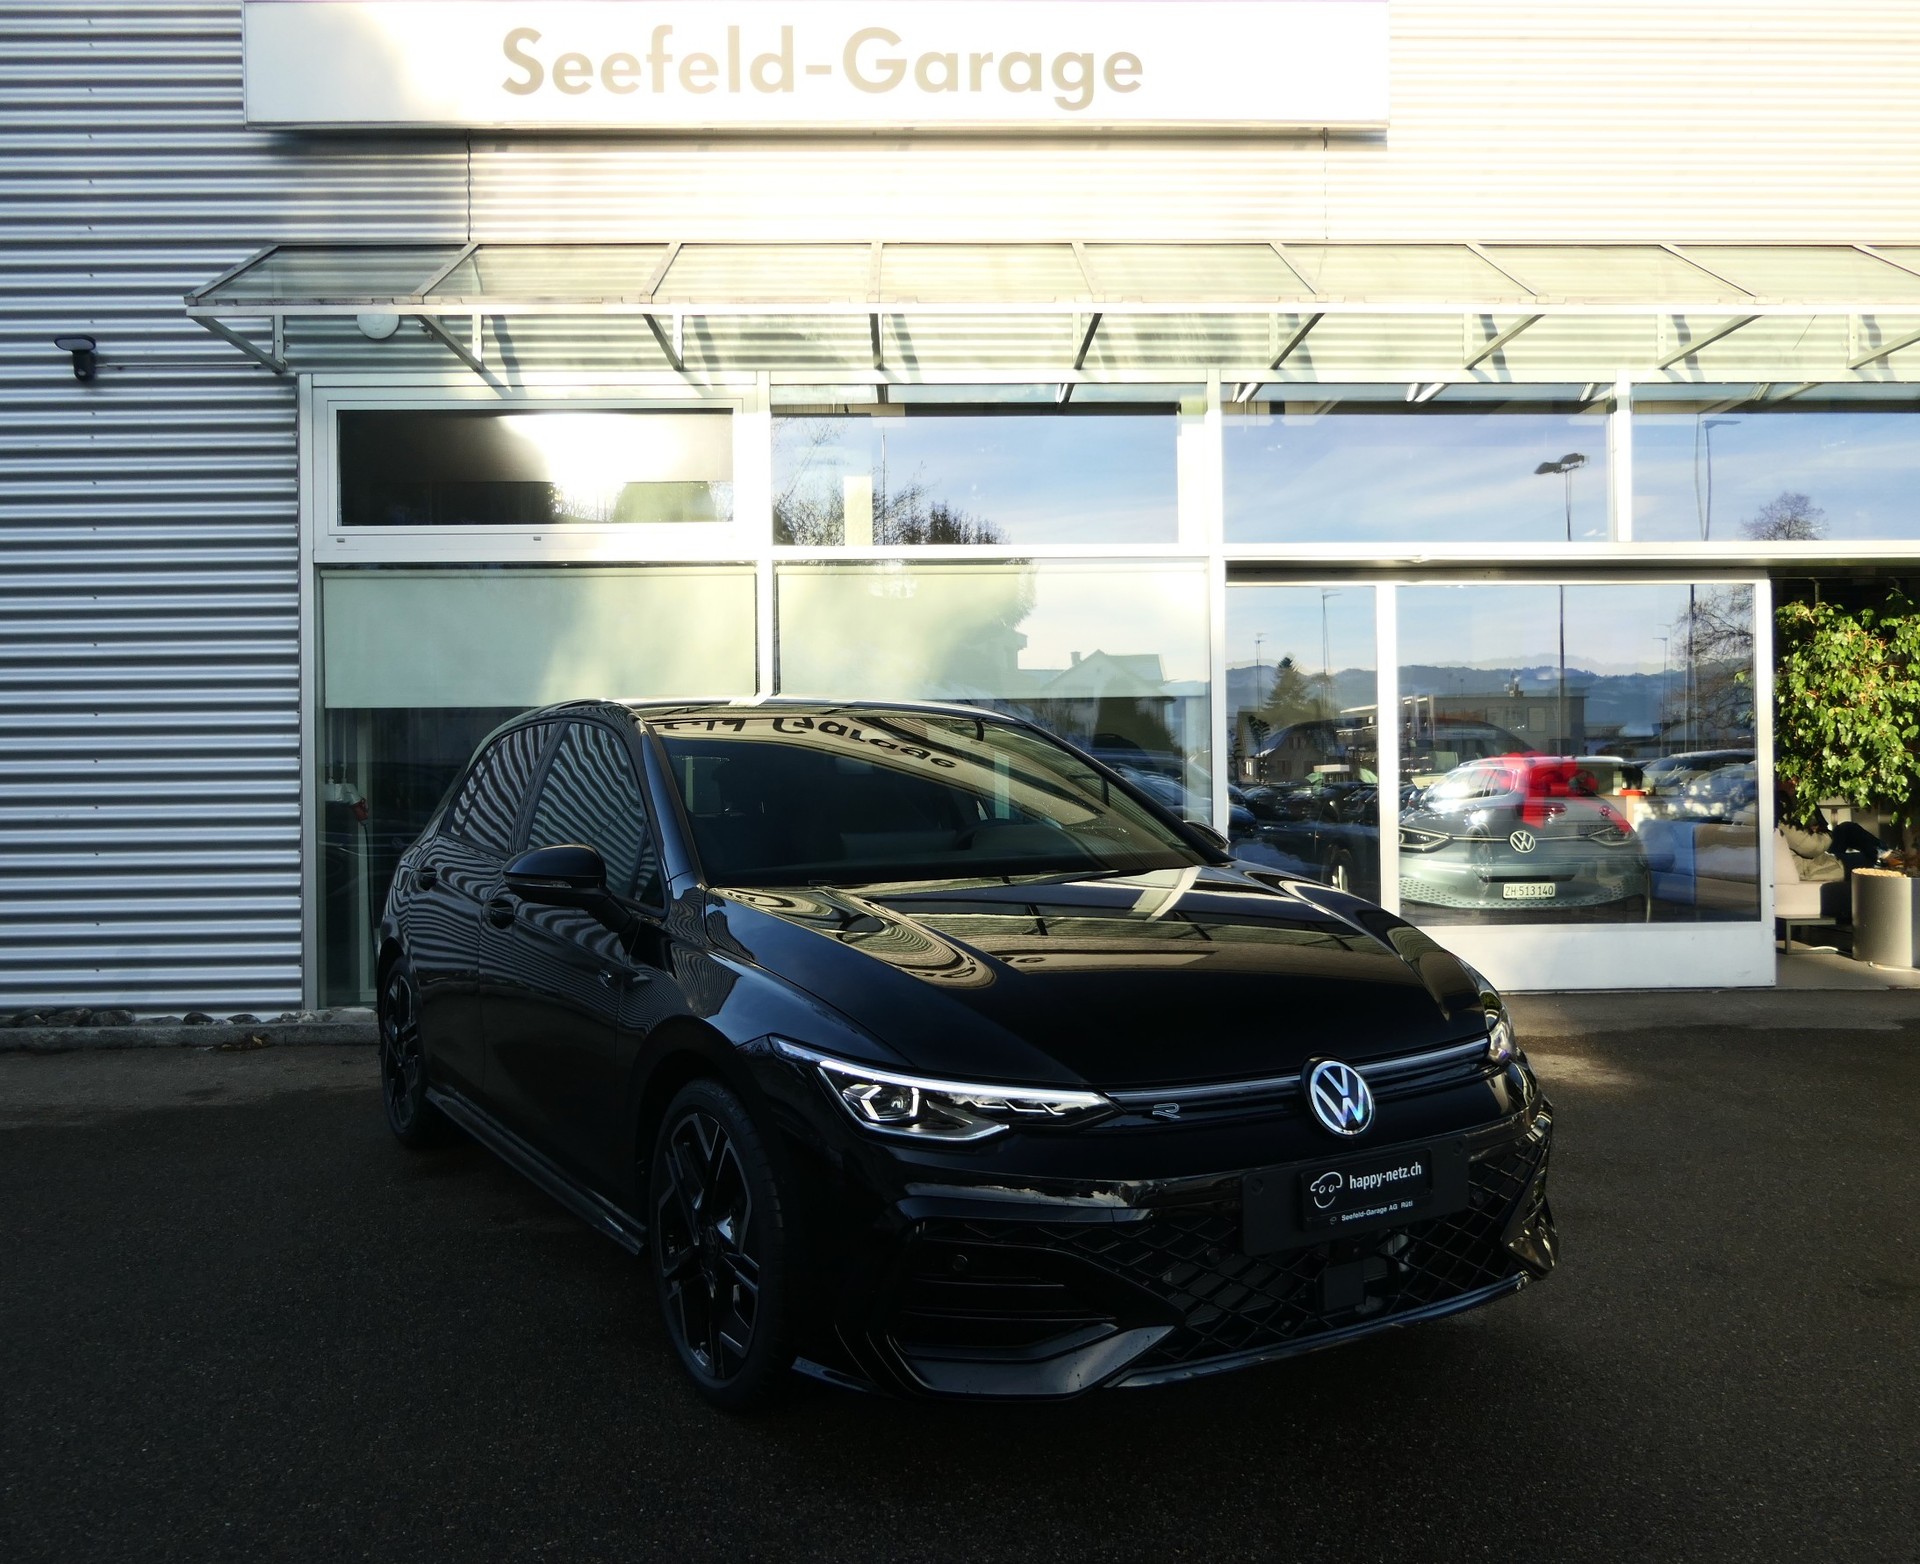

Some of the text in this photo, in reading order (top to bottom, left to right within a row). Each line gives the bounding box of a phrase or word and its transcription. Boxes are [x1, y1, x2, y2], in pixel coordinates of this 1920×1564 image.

[501, 24, 1144, 112] Seefeld-Garage
[1349, 1161, 1422, 1190] happy-netz.ch
[1341, 1207, 1388, 1222] Seefeld-Garage
[1389, 1203, 1398, 1212] AG
